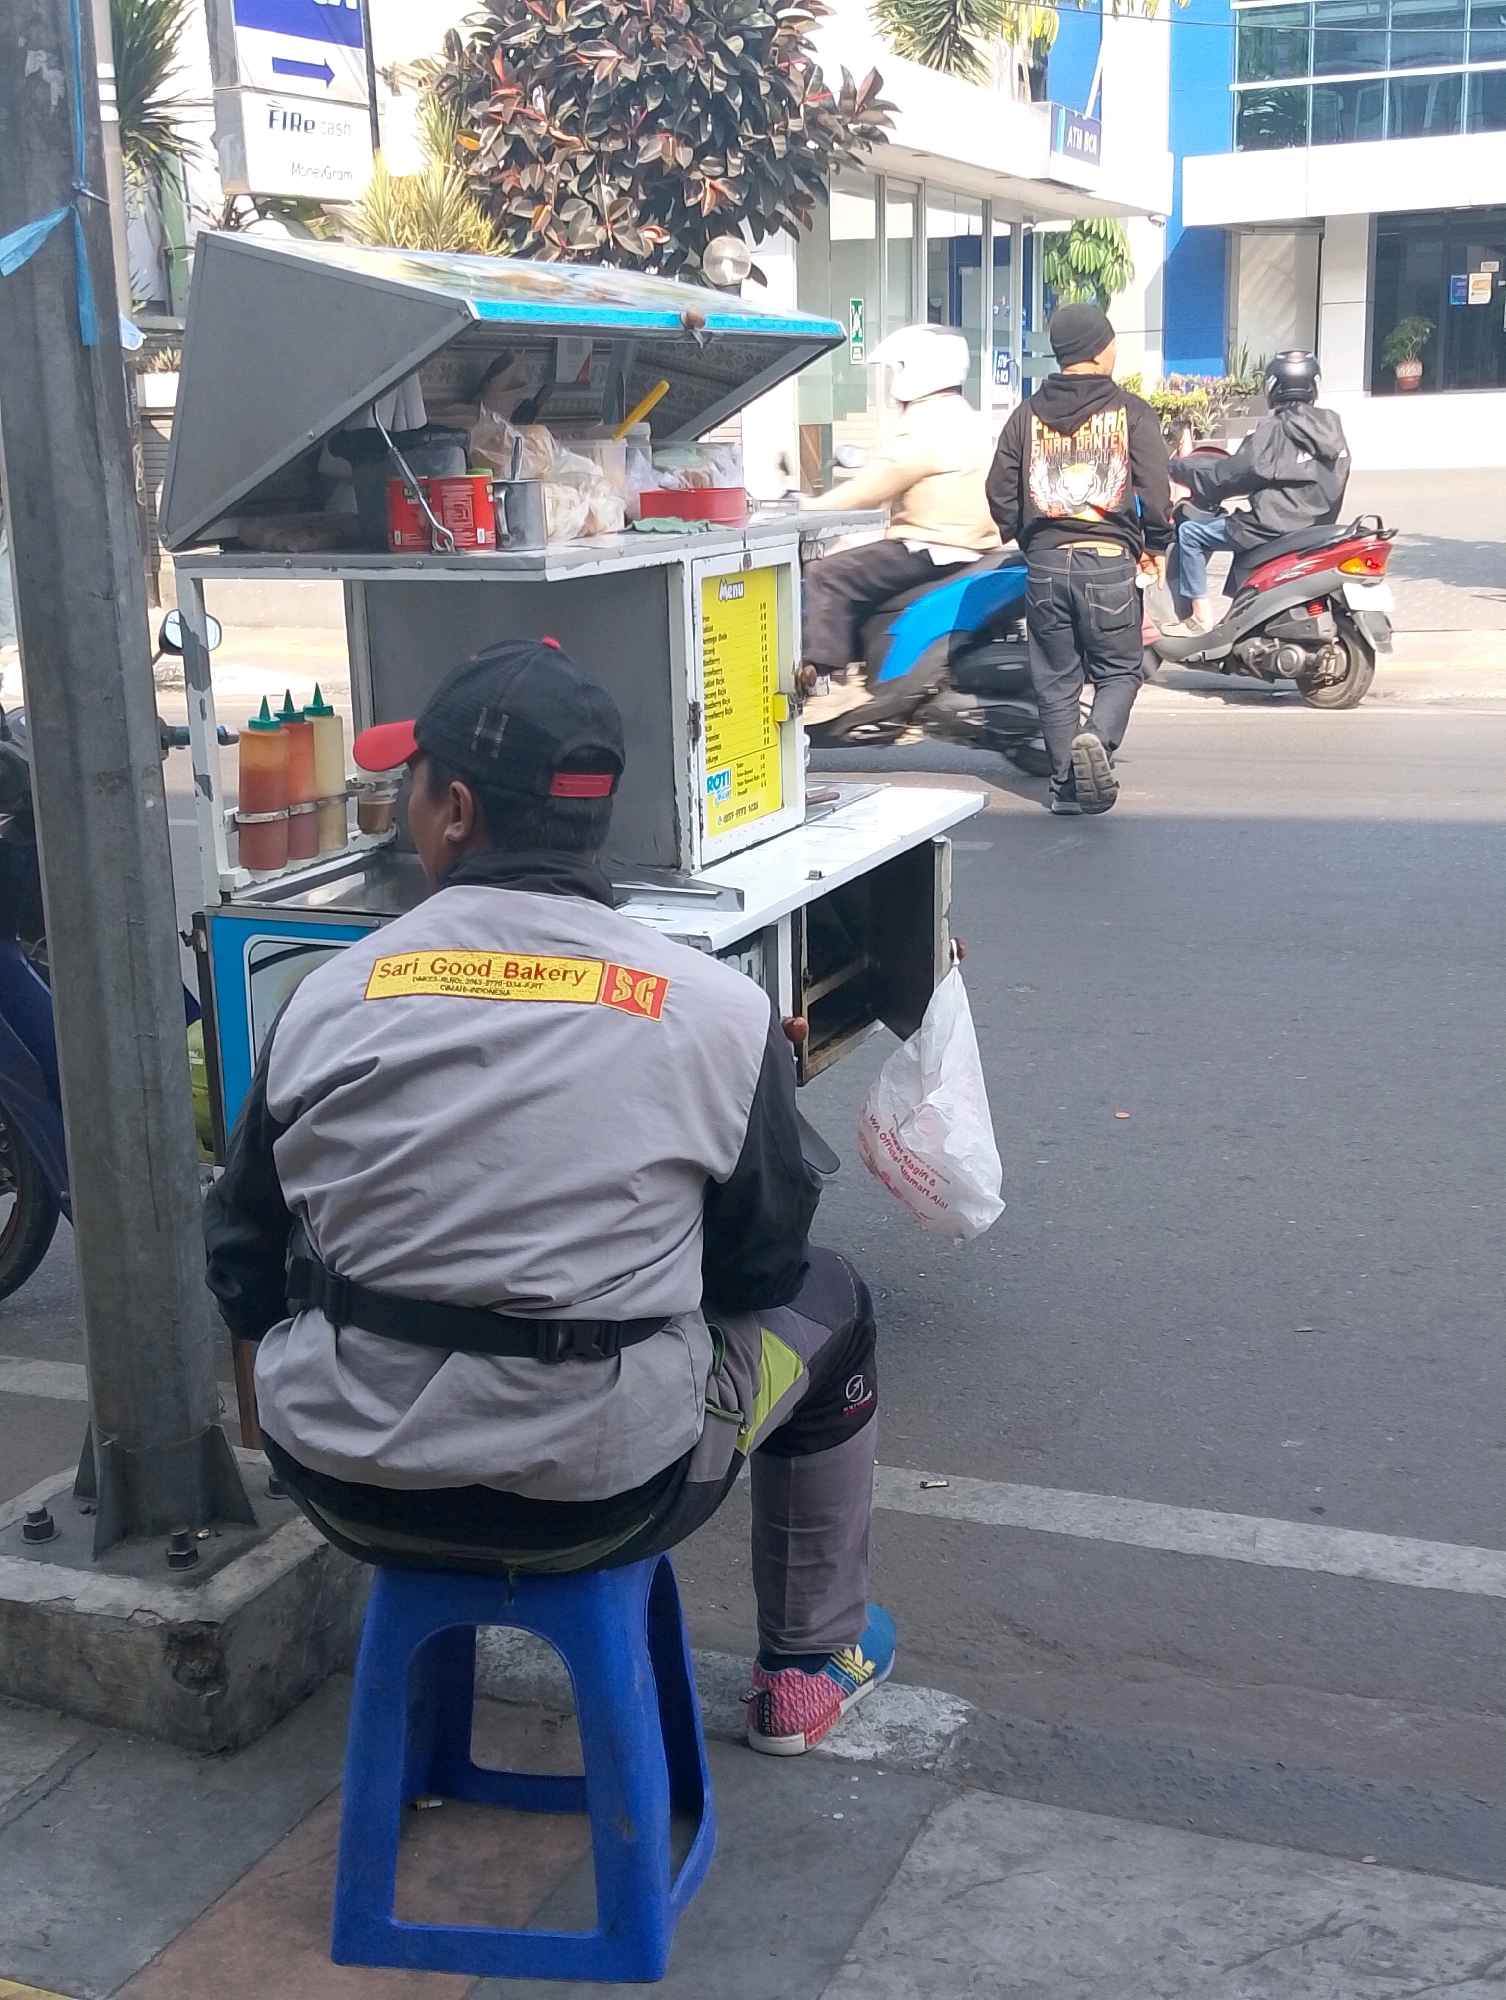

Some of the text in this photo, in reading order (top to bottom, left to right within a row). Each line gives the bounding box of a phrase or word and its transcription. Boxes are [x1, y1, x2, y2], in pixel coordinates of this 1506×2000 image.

[1066, 125, 1083, 151] ATM
[291, 162, 353, 181] MoneyGram
[718, 579, 745, 602] Menu
[706, 769, 731, 794] ROTI
[378, 958, 419, 979] Sari
[430, 957, 492, 978] Good
[503, 961, 588, 988] Bakery
[869, 1114, 881, 1133] WA
